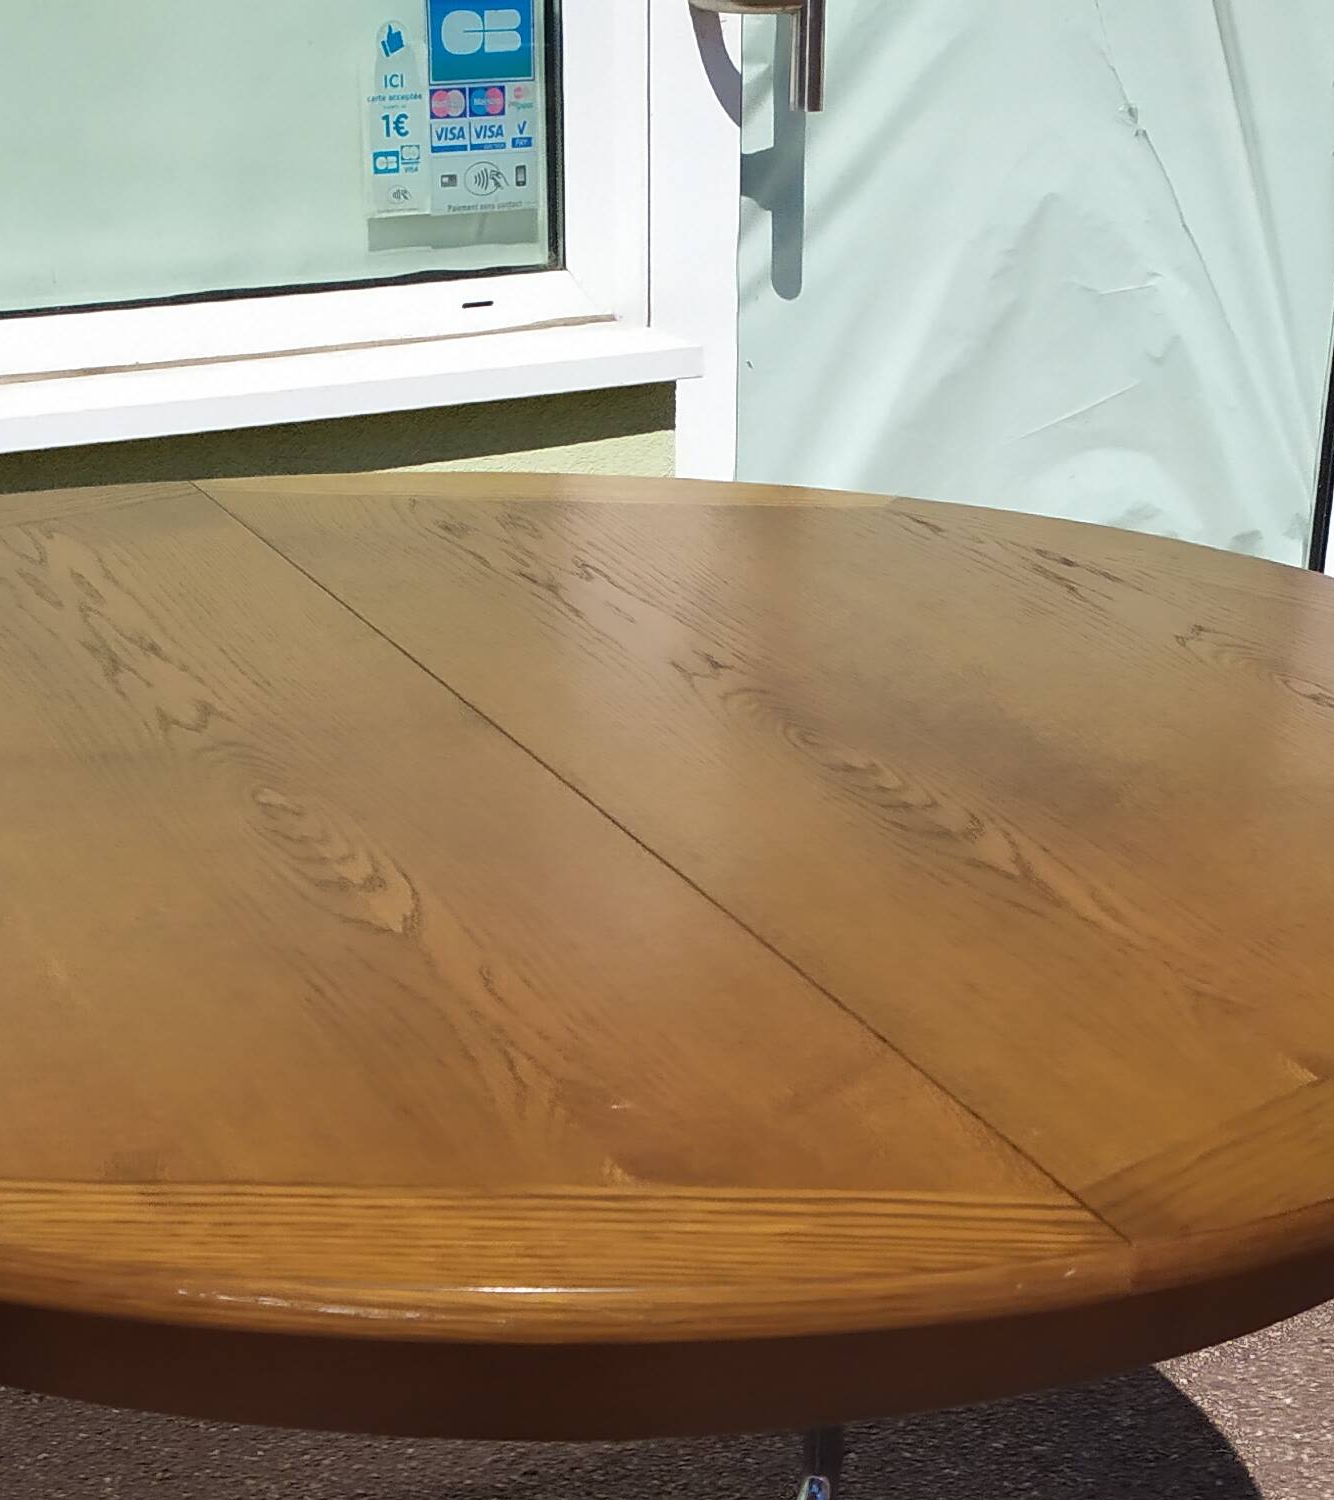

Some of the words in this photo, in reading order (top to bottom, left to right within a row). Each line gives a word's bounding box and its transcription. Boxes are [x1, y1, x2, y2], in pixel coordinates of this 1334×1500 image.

[441, 9, 522, 55] CB
[384, 74, 404, 88] ICI
[381, 113, 409, 138] 1€
[474, 124, 504, 139] VISA
[517, 120, 527, 135] V
[435, 126, 467, 141] VISA
[376, 155, 398, 170] CB
